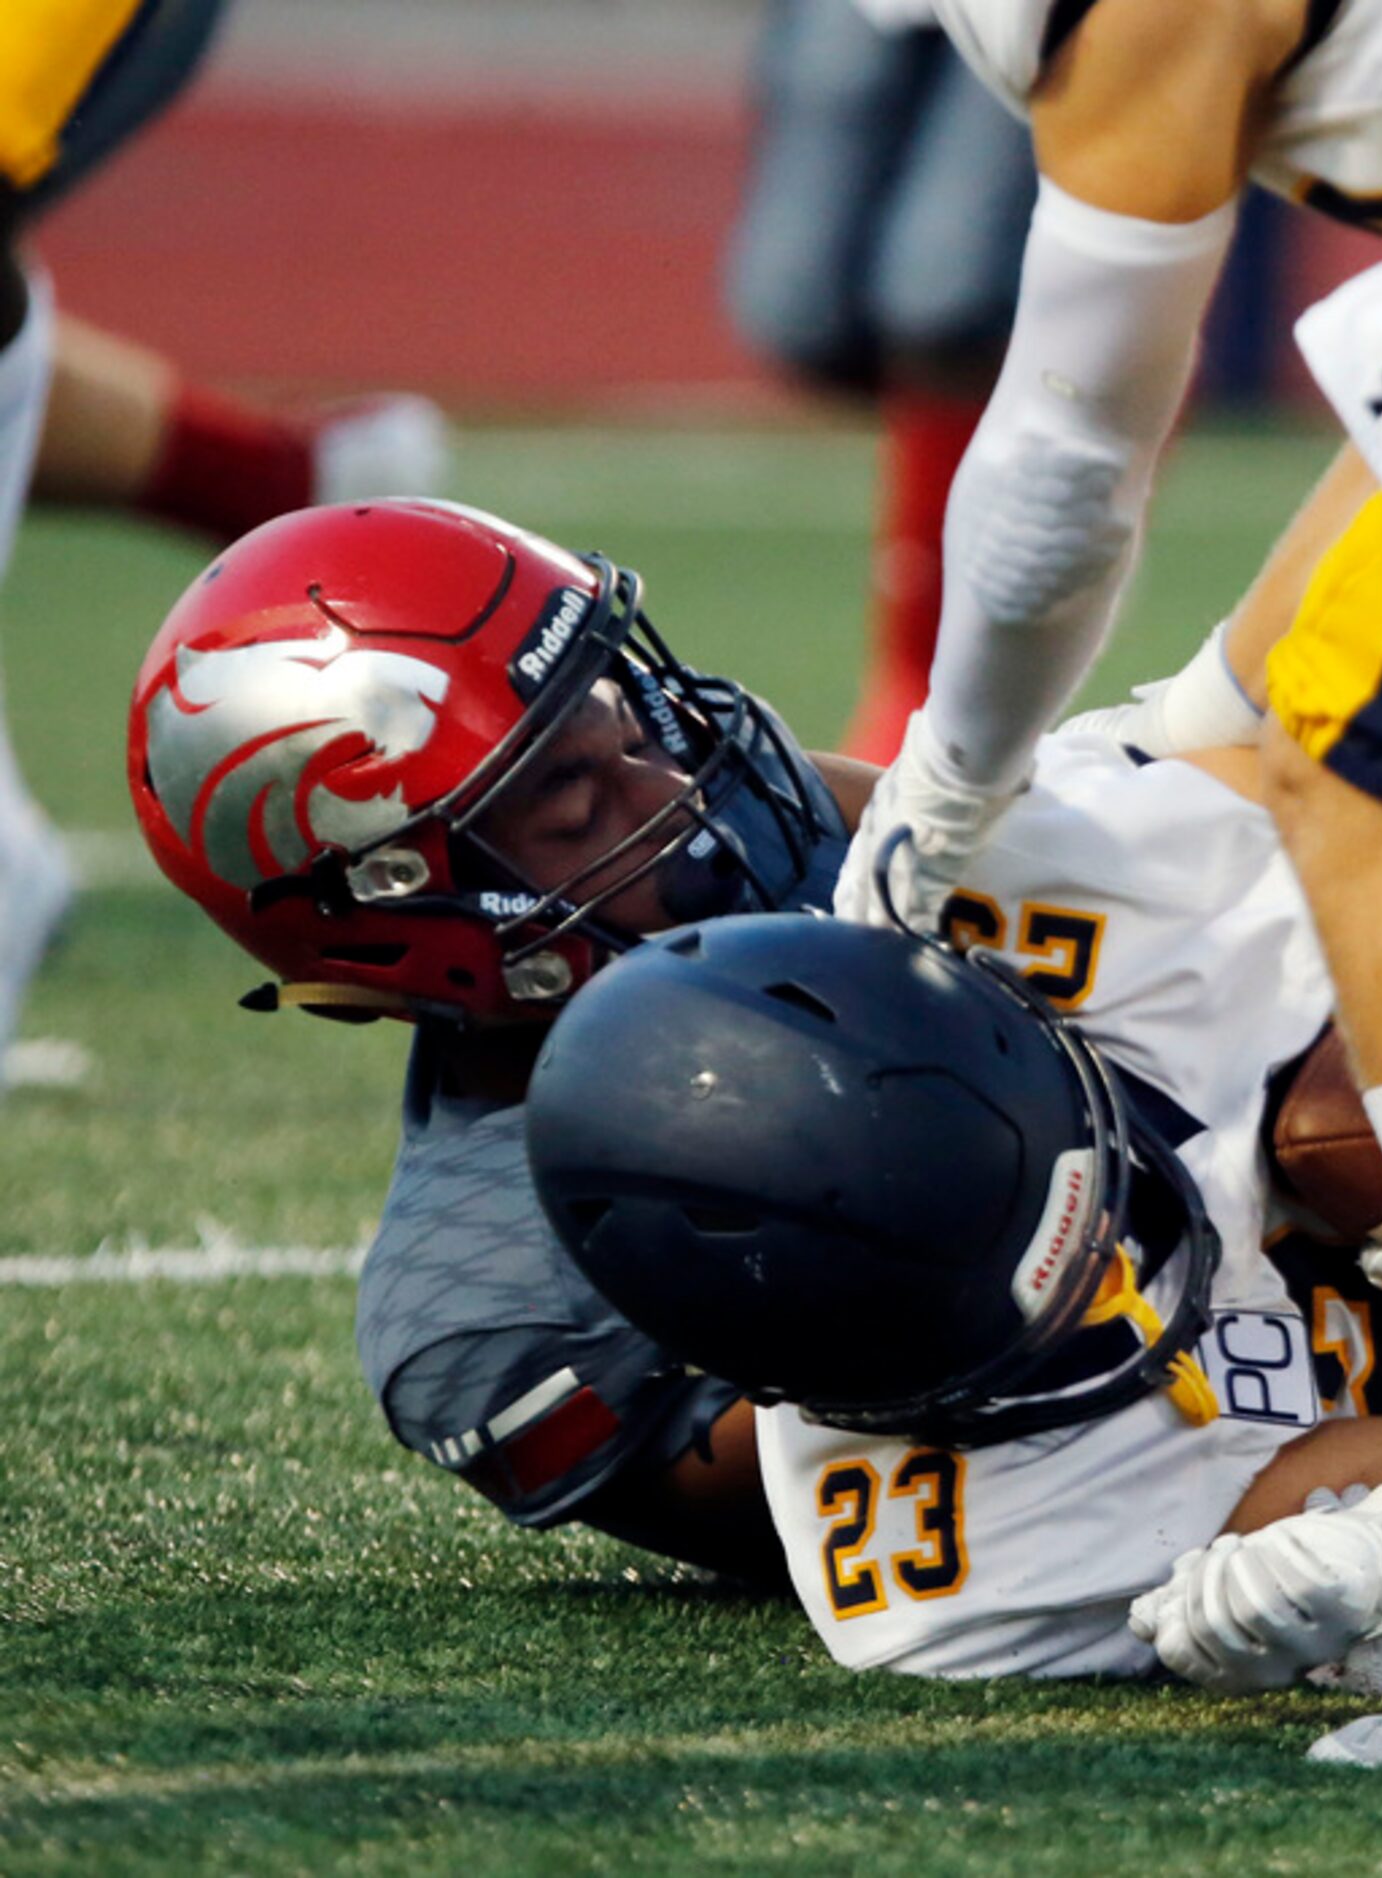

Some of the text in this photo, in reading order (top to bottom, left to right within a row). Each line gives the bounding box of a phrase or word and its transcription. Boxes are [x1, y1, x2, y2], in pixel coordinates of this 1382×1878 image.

[517, 589, 585, 683] Riddell
[1030, 1169, 1083, 1291] Riddell
[1216, 1314, 1299, 1422] PC
[815, 1446, 971, 1622] 23
